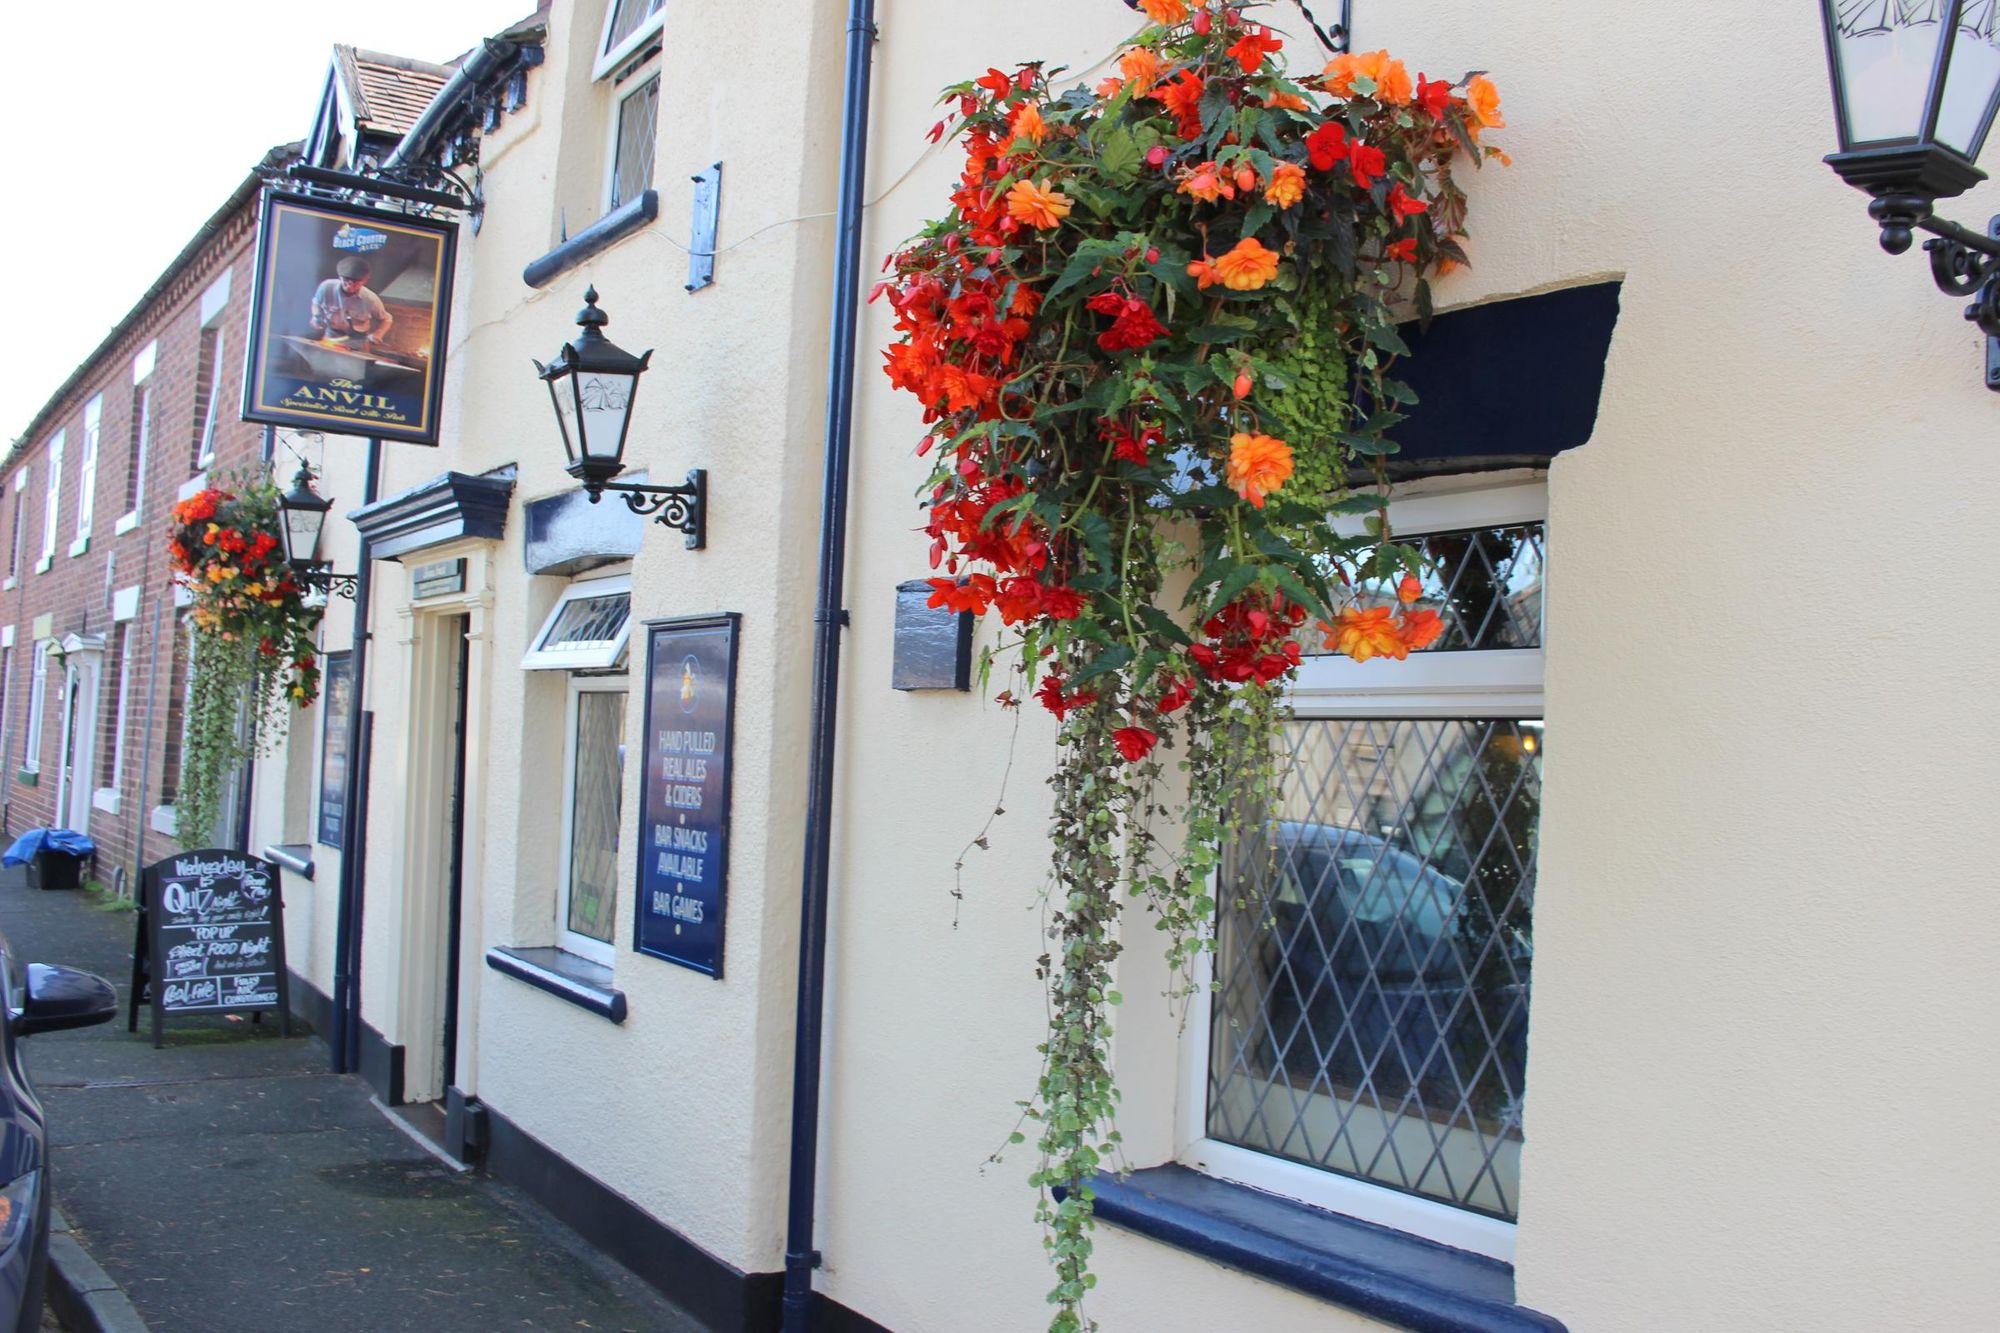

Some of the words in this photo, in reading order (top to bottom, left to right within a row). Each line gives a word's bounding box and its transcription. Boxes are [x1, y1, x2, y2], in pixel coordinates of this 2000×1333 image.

[329, 378, 363, 391] The
[293, 385, 396, 410] ANVIL
[659, 730, 682, 753] HAND
[683, 731, 716, 755] PULLED
[662, 757, 683, 781] REAL
[685, 759, 707, 782] ALES
[665, 784, 672, 807] &
[673, 785, 703, 809] CIDERS
[655, 824, 672, 848] BAR
[673, 827, 707, 854] SNACKS
[175, 855, 247, 879] Wednesday
[657, 852, 704, 882] AVAILABLE
[653, 890, 671, 917] BAR
[672, 895, 704, 924] GAMES
